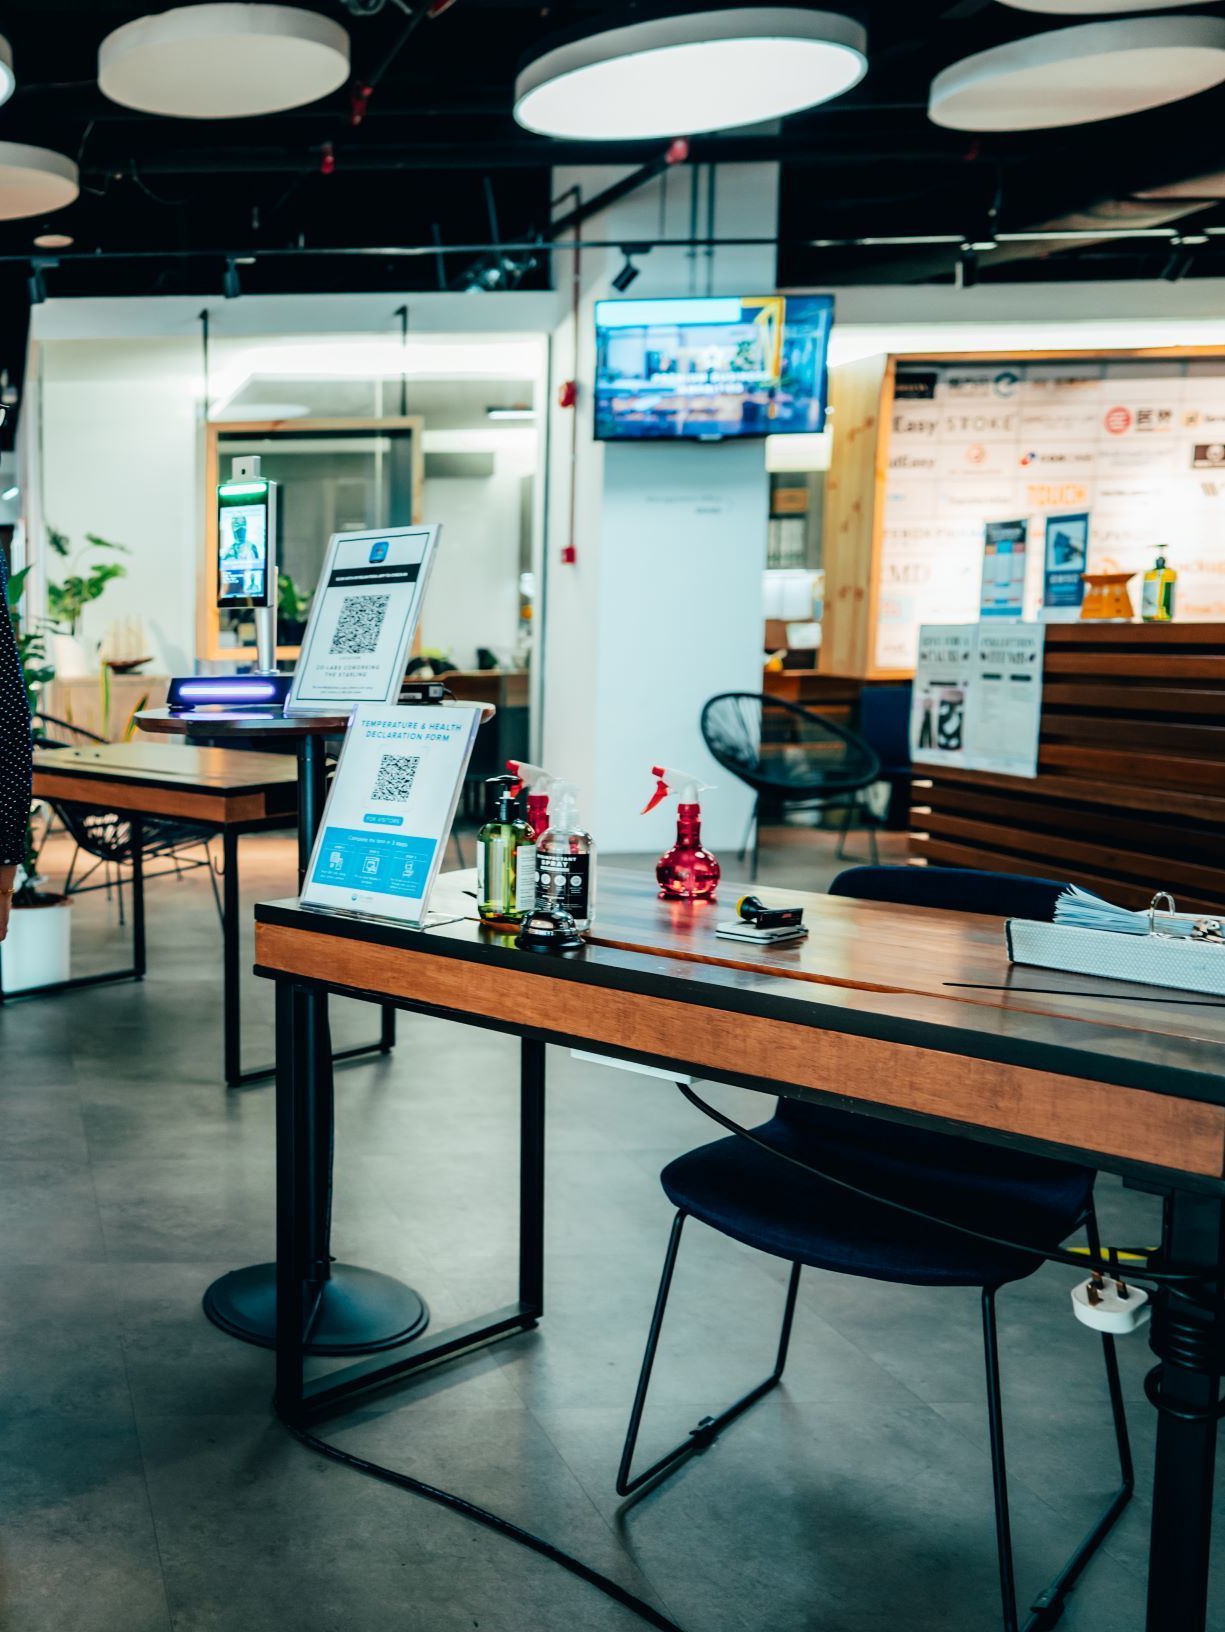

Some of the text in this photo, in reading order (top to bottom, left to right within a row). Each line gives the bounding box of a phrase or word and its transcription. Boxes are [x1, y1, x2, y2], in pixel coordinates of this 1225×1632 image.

[361, 720, 419, 730] TEMPERATURE
[429, 722, 463, 732] HEALTH
[365, 731, 451, 742] DECLARATION FORM
[541, 859, 569, 867] SPRAY
